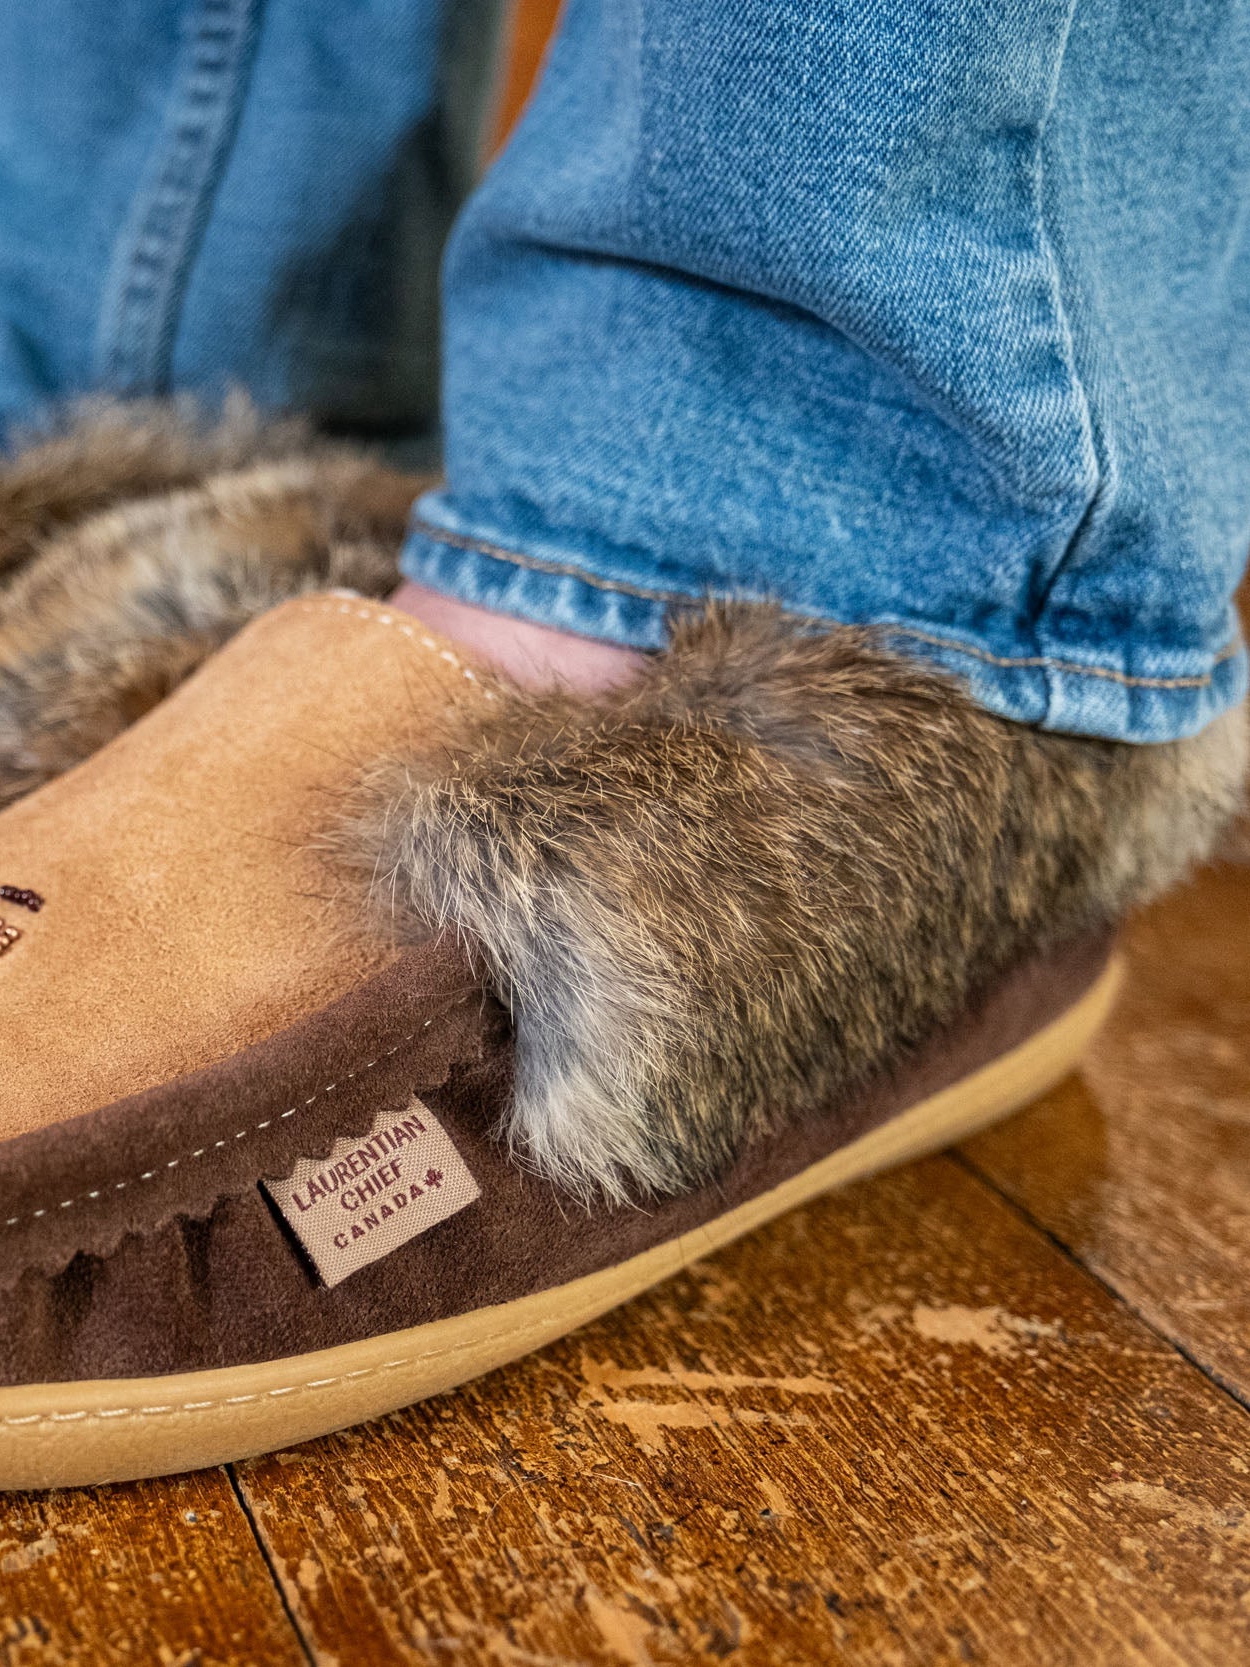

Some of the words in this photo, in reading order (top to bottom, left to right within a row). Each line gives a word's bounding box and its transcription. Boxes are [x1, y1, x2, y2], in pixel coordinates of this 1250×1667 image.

[292, 1115, 427, 1212] LAURENTIAN
[340, 1158, 403, 1211] CHIEF
[333, 1184, 424, 1249] CANADA
